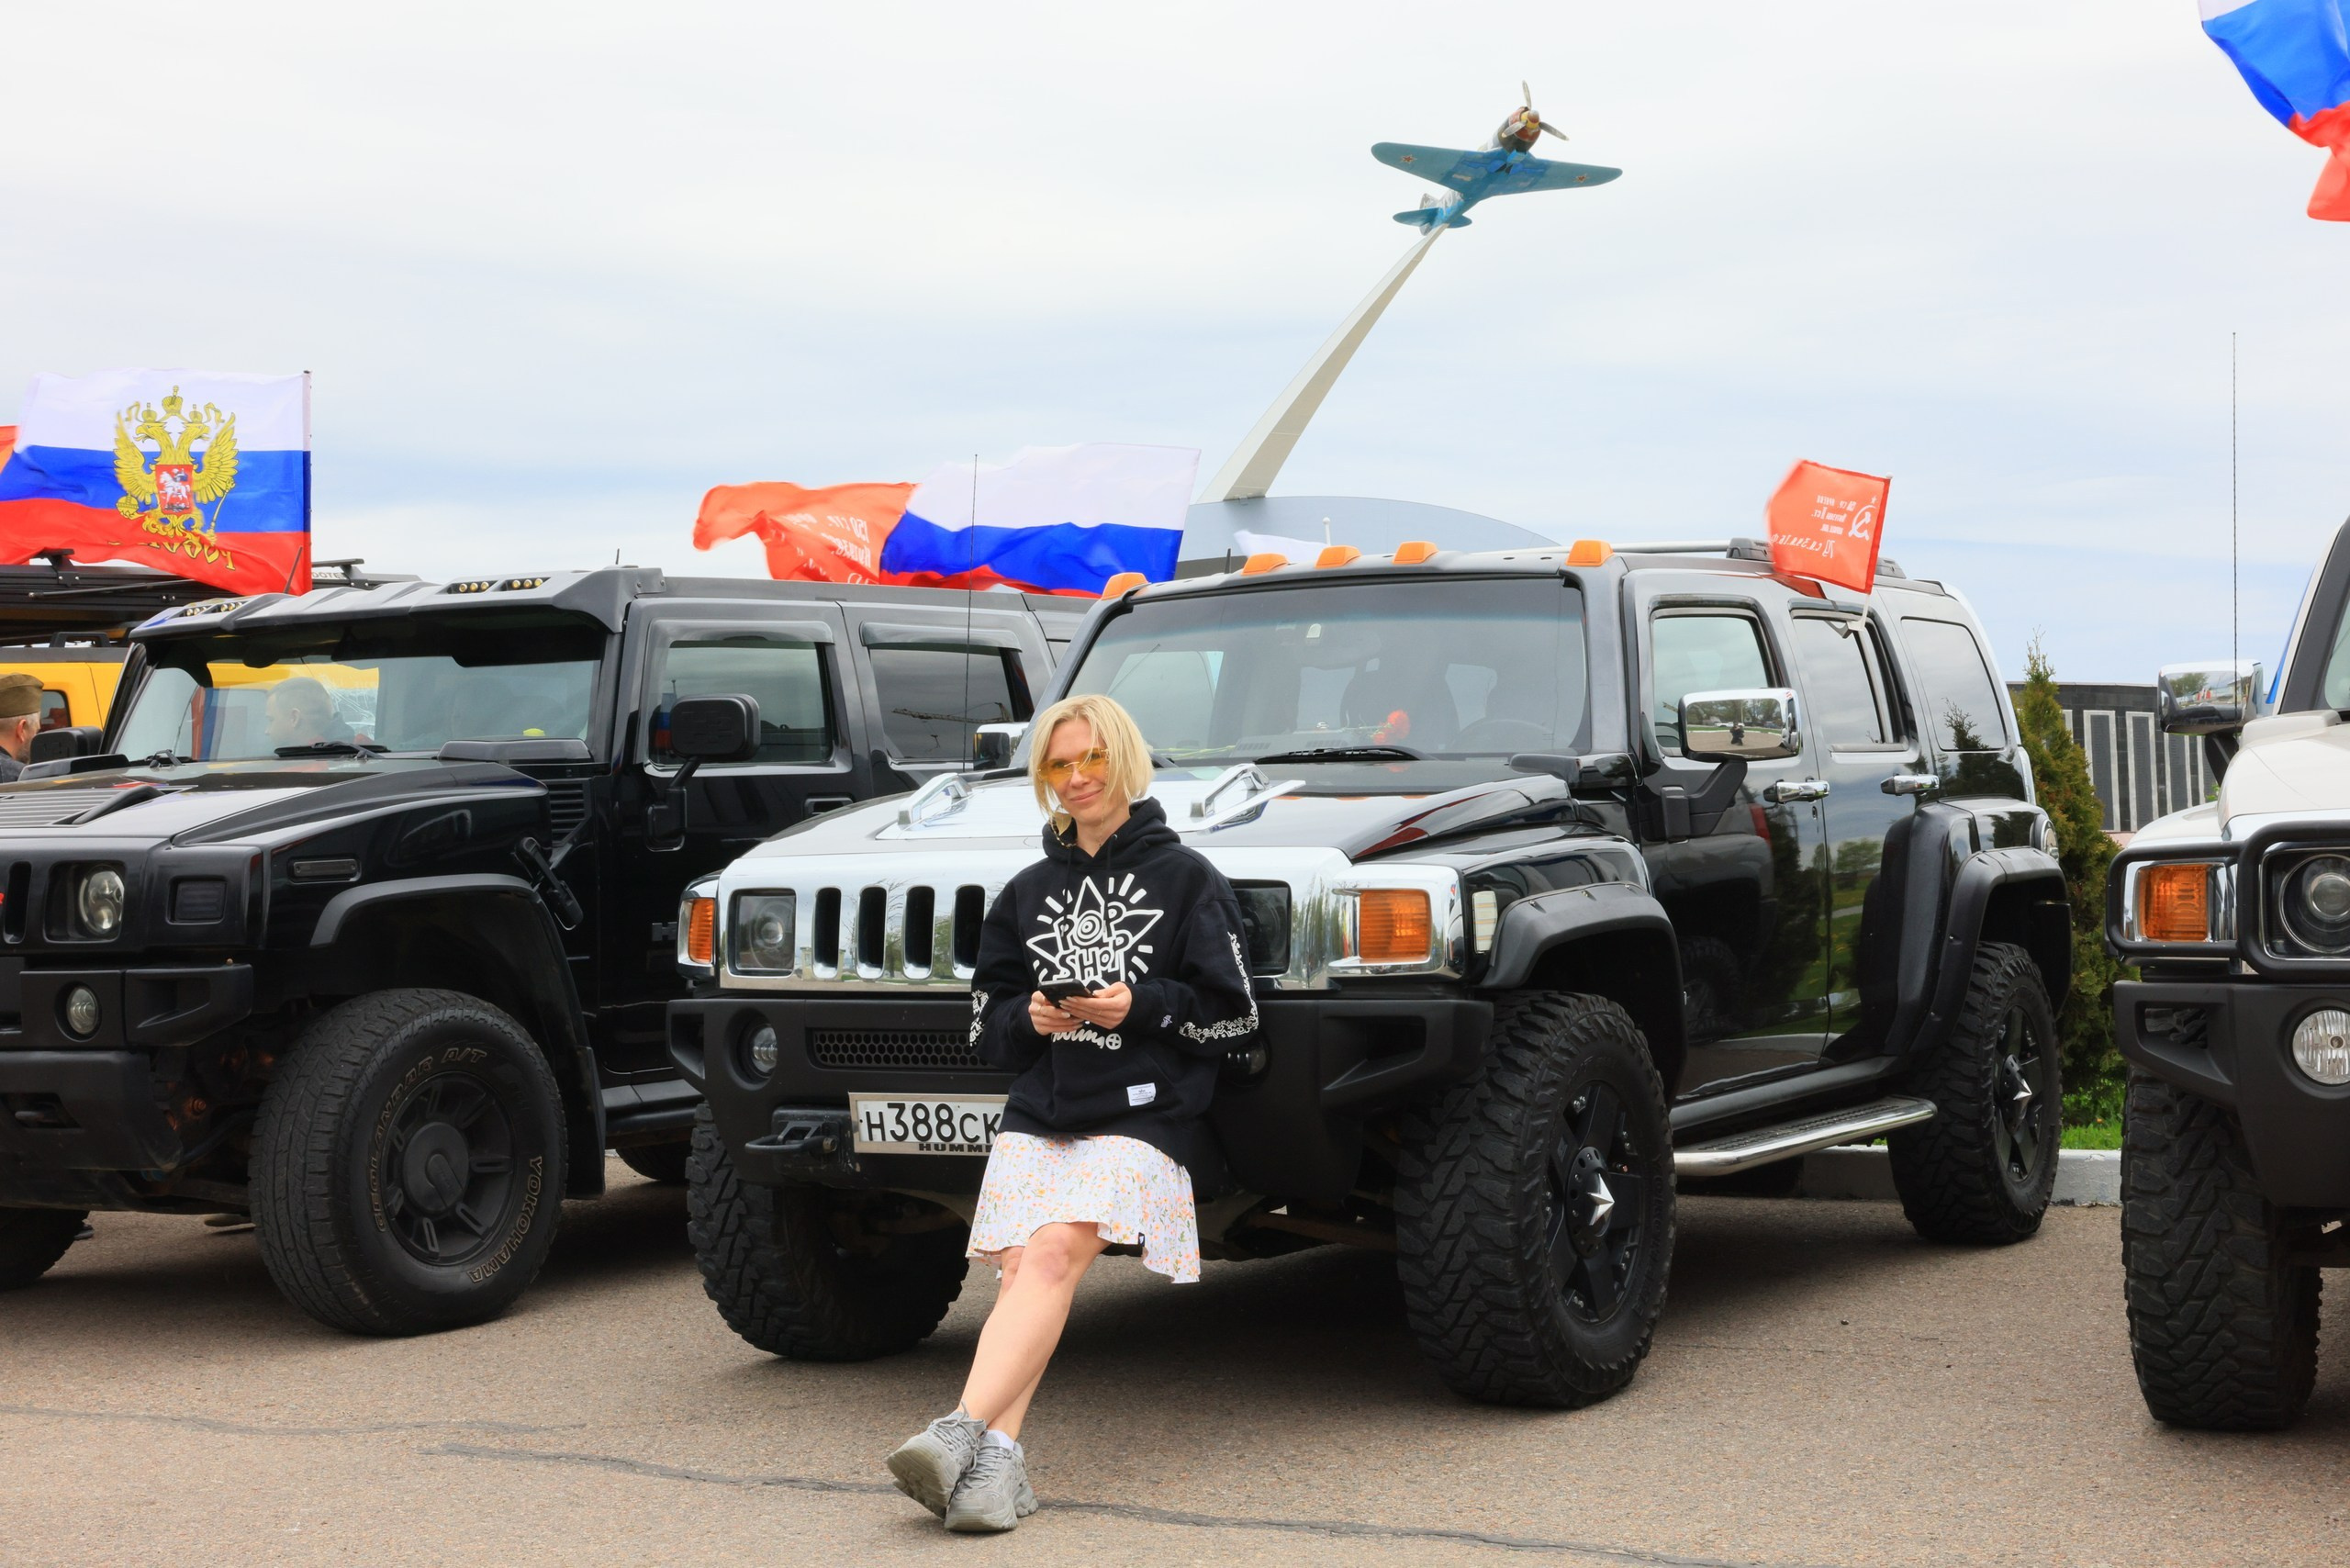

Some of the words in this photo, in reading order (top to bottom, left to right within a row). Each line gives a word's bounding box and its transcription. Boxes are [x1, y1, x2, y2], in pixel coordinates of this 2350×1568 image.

[1053, 902, 1127, 951] POP
[1053, 930, 1133, 981] SHOP
[441, 1047, 487, 1064] A/T
[467, 1155, 543, 1283] YOKOHAMA
